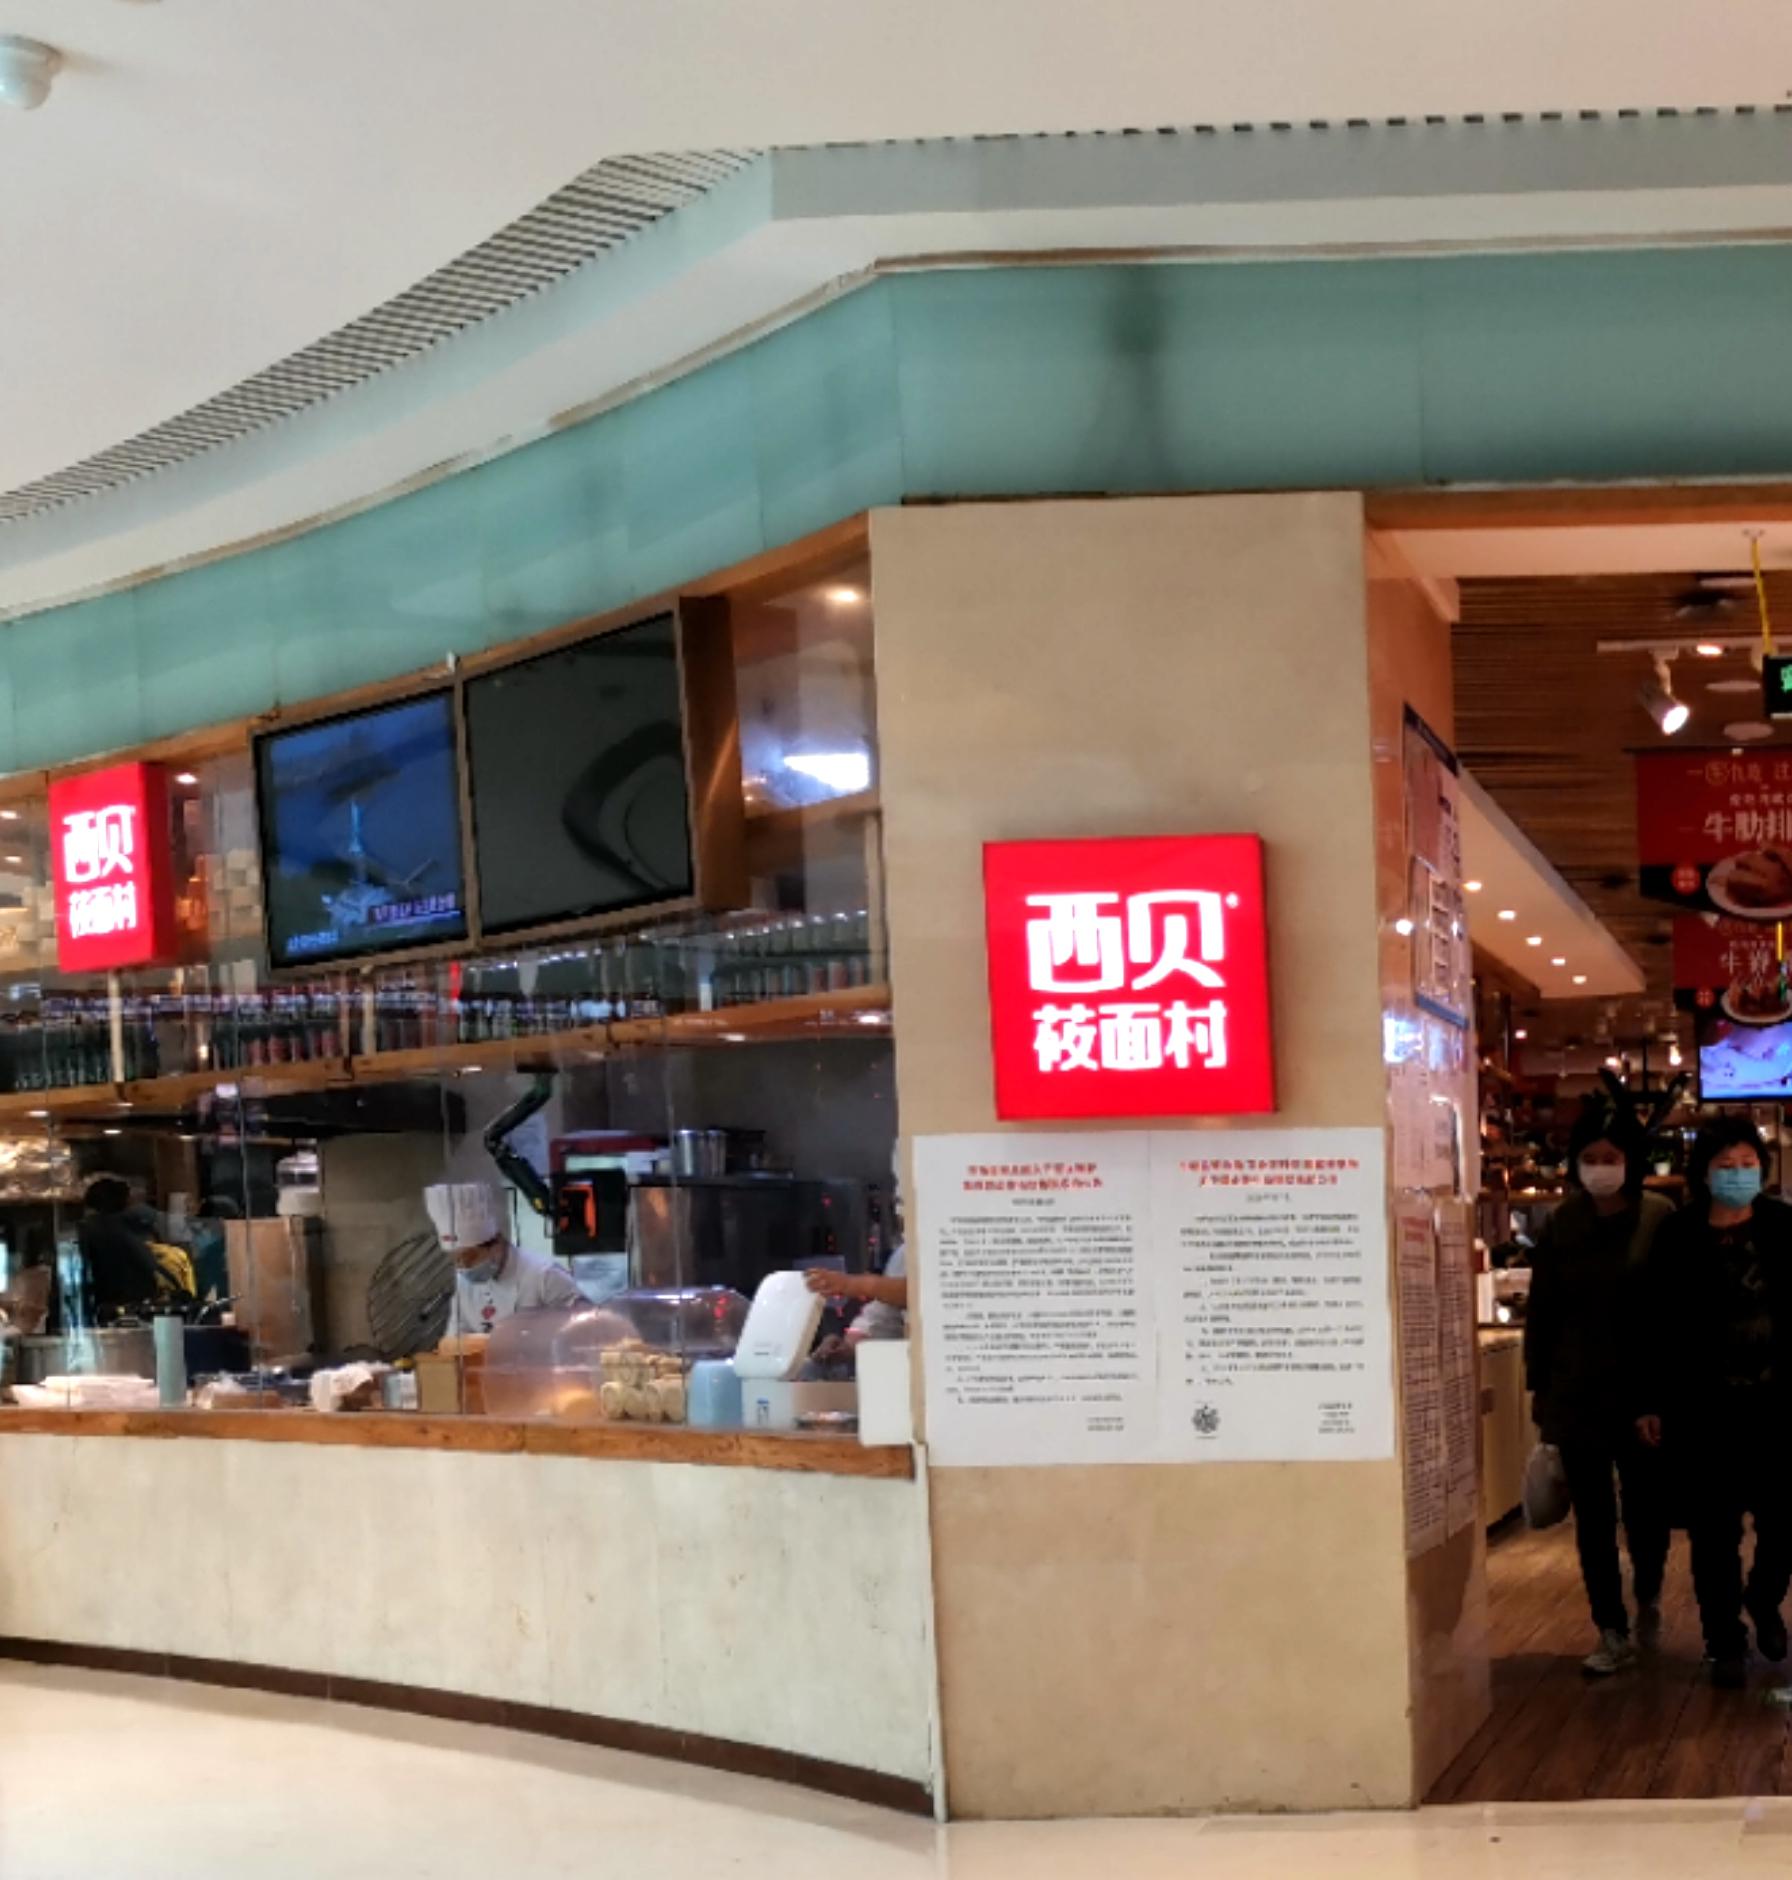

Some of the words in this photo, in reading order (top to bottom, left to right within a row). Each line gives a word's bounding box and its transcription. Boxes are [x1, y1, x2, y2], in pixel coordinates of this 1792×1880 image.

[62, 804, 137, 883] 西贝
[69, 880, 138, 938] 莜面村
[1025, 889, 1226, 993] 西贝
[1032, 1000, 1227, 1072] 莜面村
